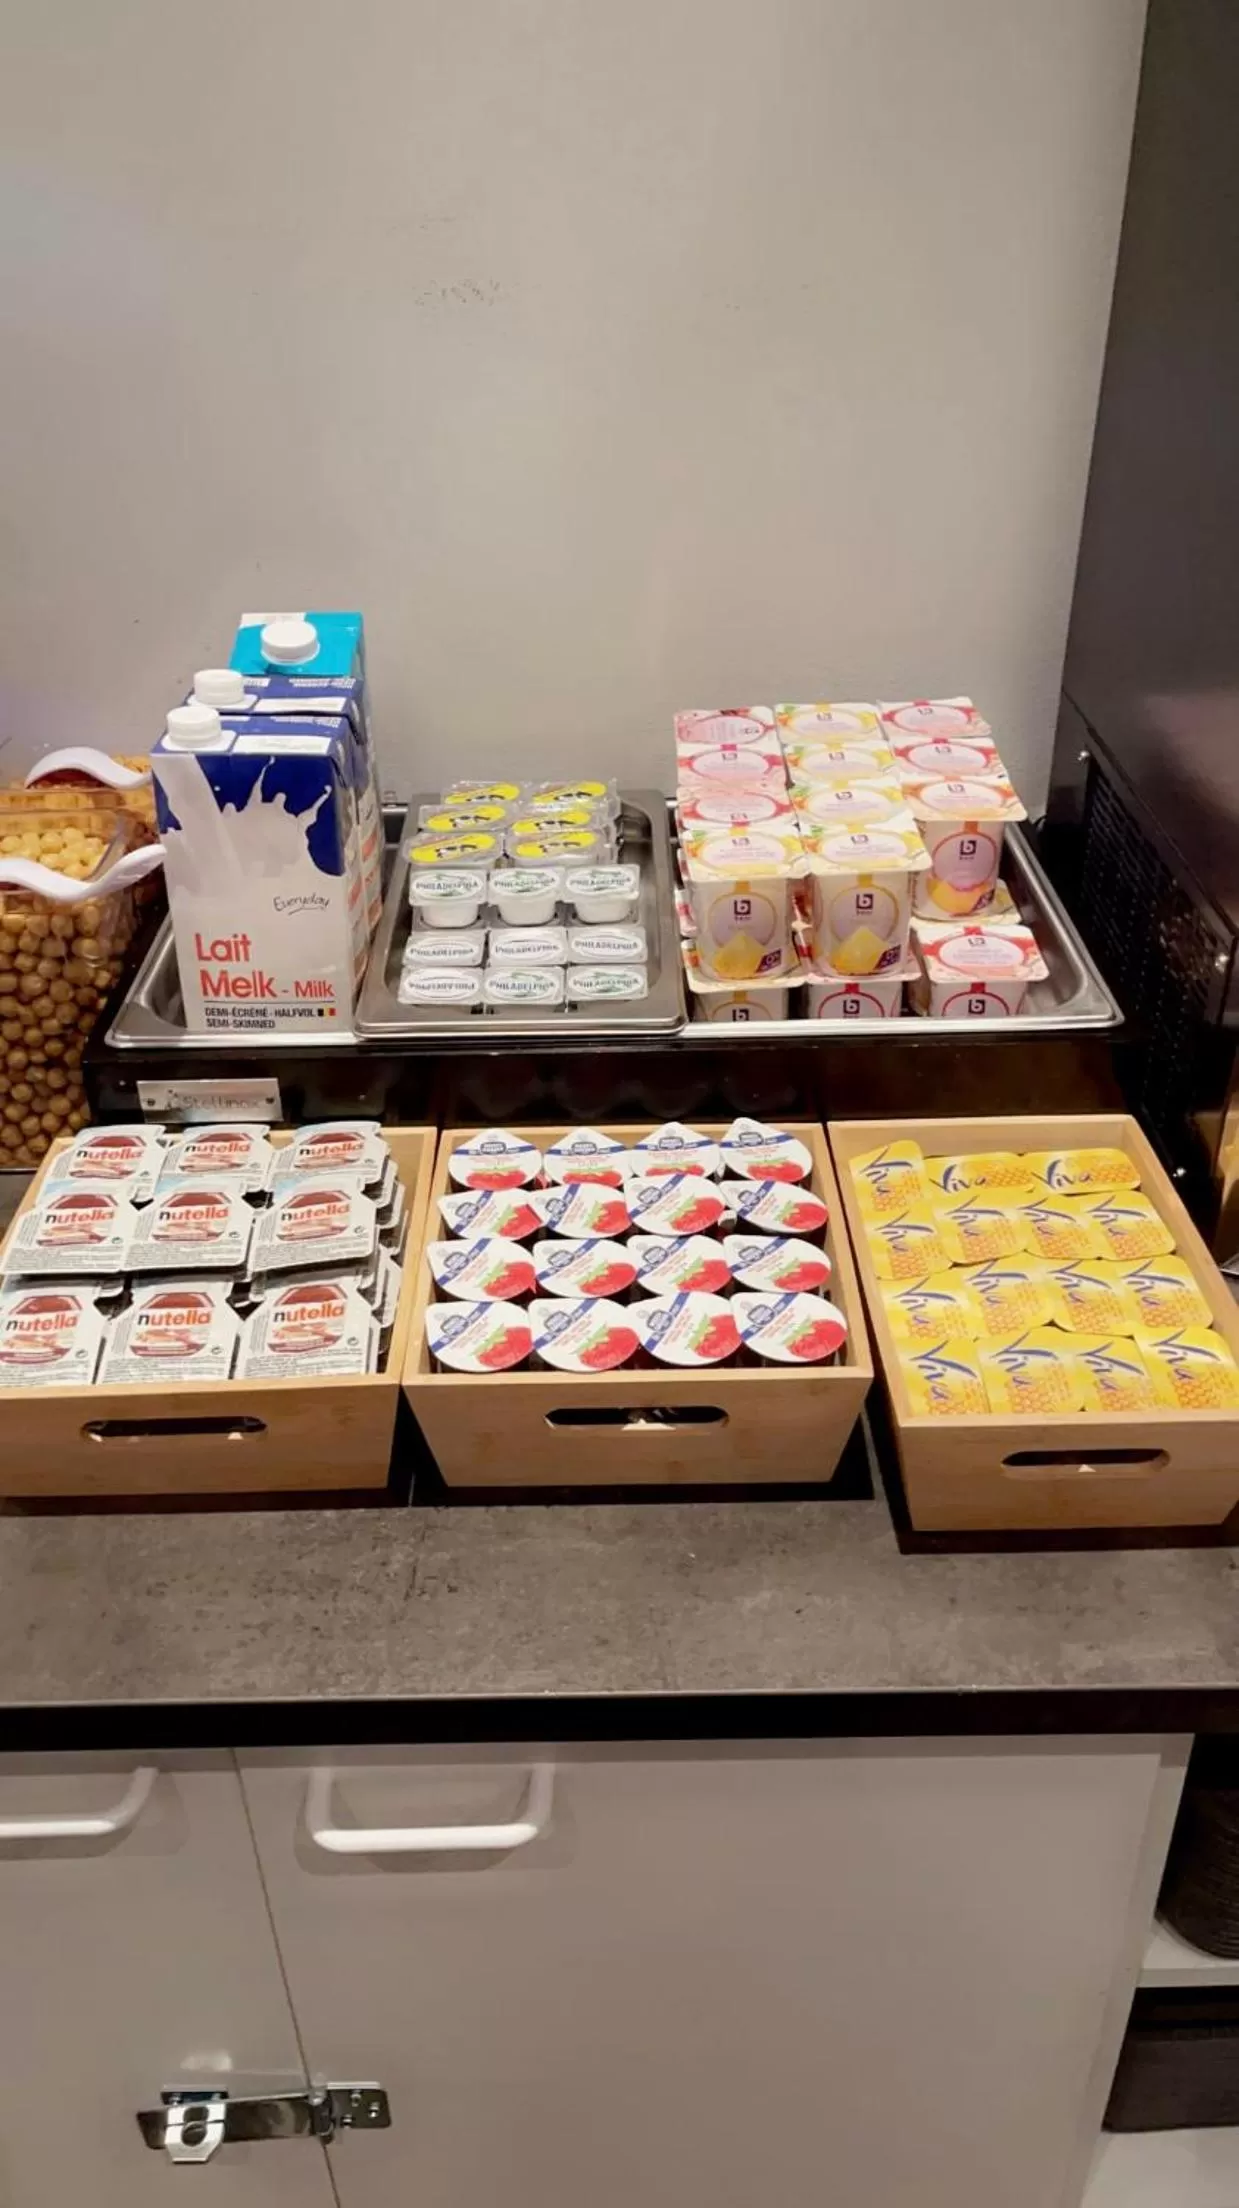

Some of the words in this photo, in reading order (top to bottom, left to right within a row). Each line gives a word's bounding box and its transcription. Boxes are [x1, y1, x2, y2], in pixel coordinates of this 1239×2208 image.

[273, 893, 330, 914] Everyday
[195, 932, 251, 962] Lait
[200, 969, 277, 998] Melk
[294, 980, 335, 998] Milk
[206, 1018, 276, 1028] SEMI-SKIMMED
[274, 1007, 316, 1017] HALFVOL
[76, 1147, 144, 1160] nutella
[184, 1142, 251, 1153] nutella
[299, 1142, 365, 1156] nutella
[860, 1146, 913, 1193] Viva
[928, 1164, 986, 1193] Viva
[1031, 1159, 1091, 1189] Viva
[45, 1210, 115, 1224] nutella
[159, 1206, 229, 1221] nutella
[281, 1203, 350, 1222] nutella
[945, 1195, 1005, 1237] Viva
[1018, 1197, 1077, 1236] Viva
[1086, 1195, 1148, 1235] Viva
[875, 1211, 934, 1252] Viva
[965, 1259, 1029, 1304] Viva
[1047, 1260, 1112, 1304] Viva
[1120, 1260, 1185, 1306] Viva
[273, 1303, 345, 1323] nutella
[894, 1276, 957, 1324] Viva
[5, 1313, 78, 1331] nutella
[138, 1309, 212, 1326] nutella
[909, 1340, 977, 1399] Viva
[988, 1331, 1059, 1386] Viva
[1076, 1342, 1144, 1391] Viva
[1149, 1328, 1221, 1381] Viva
